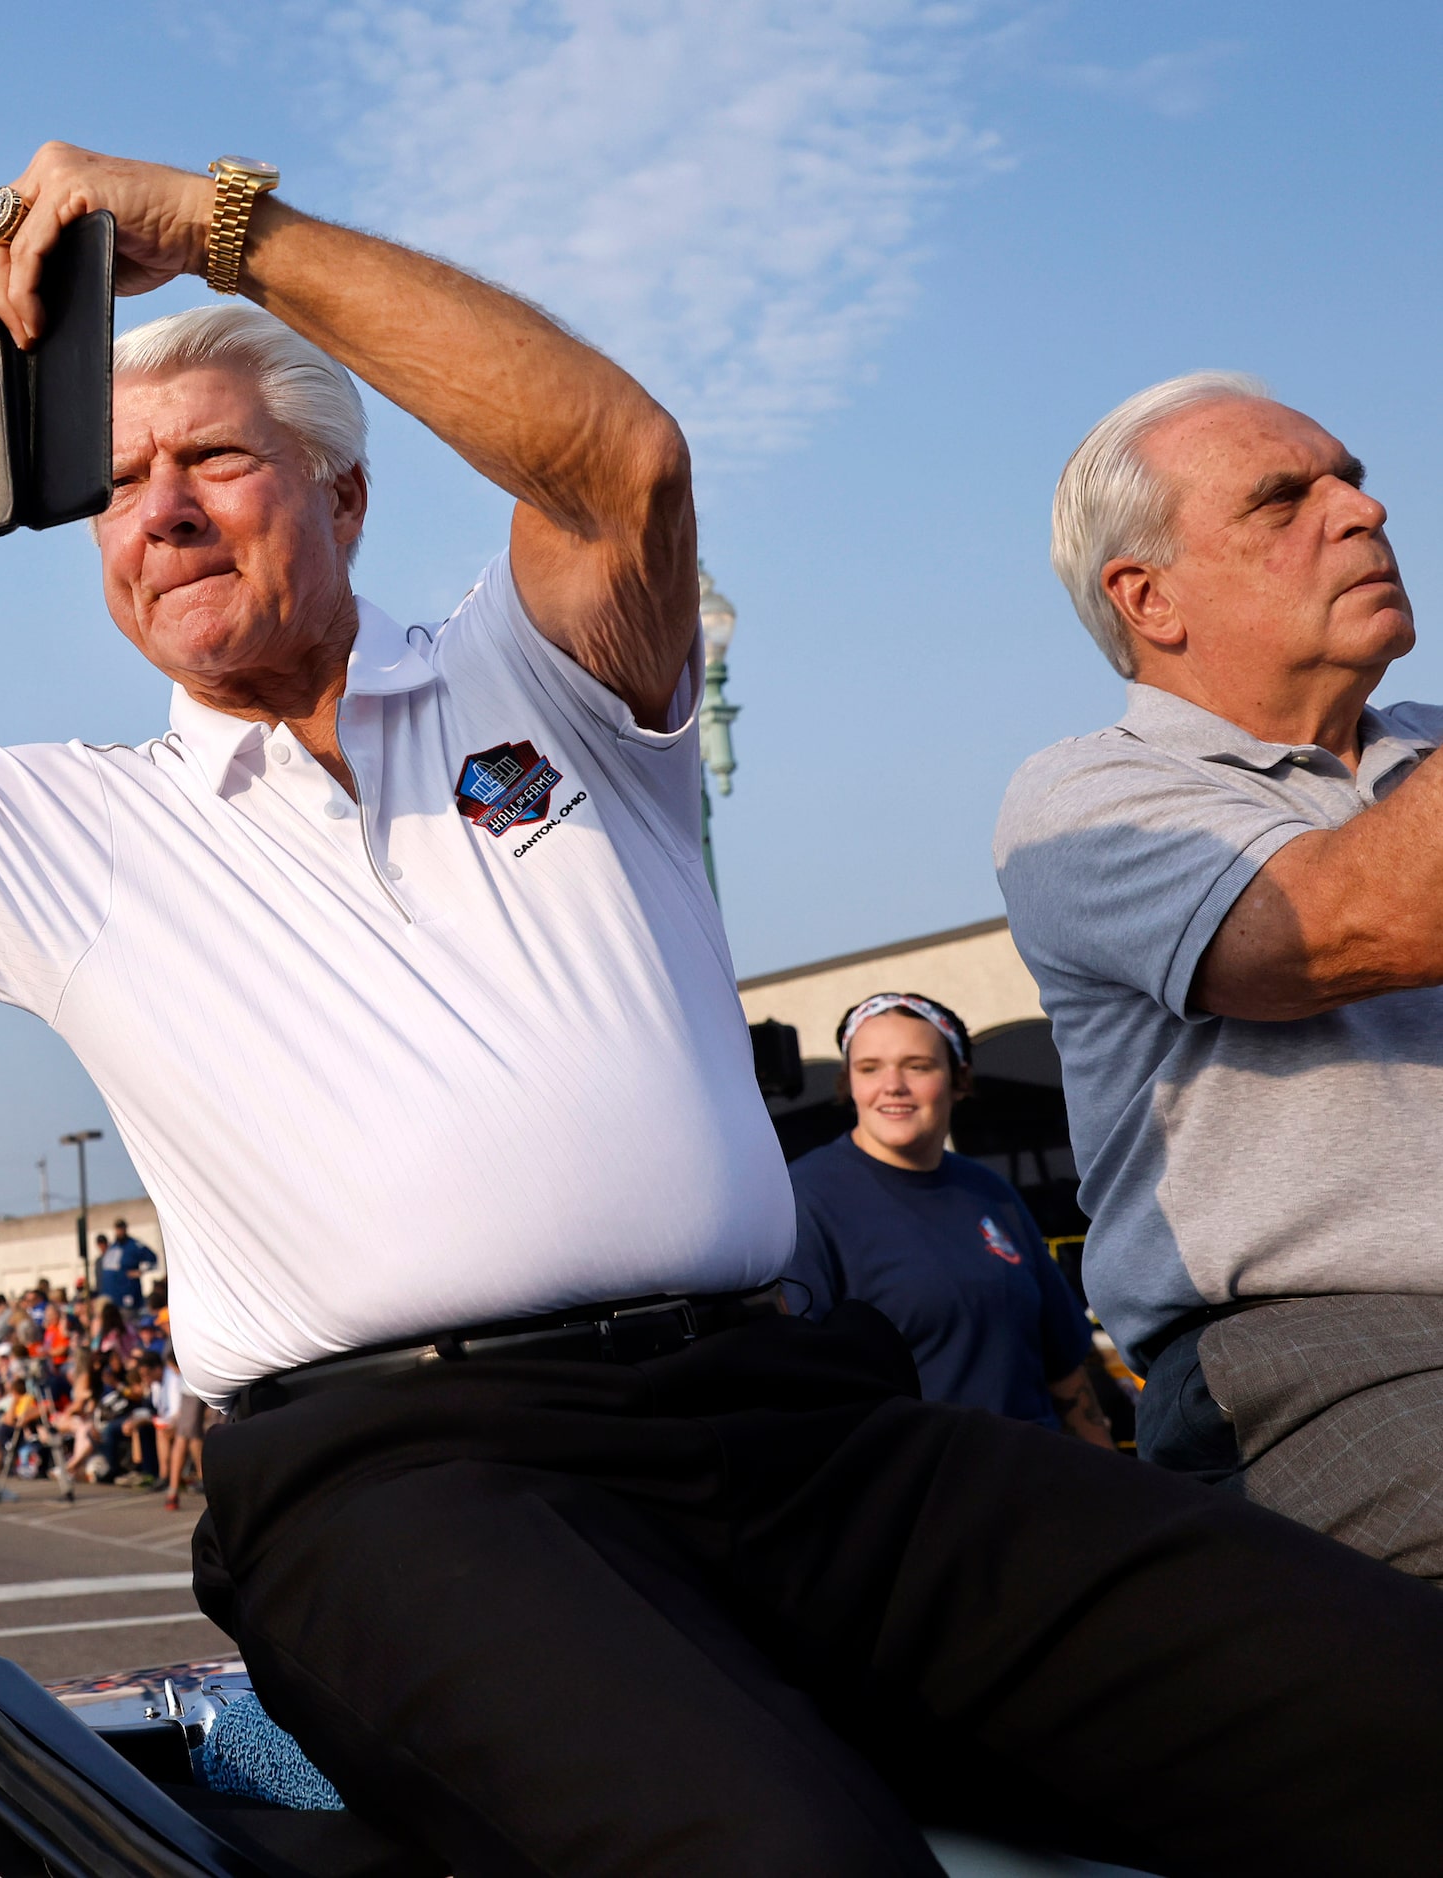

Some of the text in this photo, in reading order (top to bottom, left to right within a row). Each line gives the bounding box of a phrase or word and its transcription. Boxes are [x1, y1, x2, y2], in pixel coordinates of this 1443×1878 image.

[477, 806, 499, 825] PRO
[490, 770, 556, 831] HALL OF FAME
[514, 791, 587, 858] CANTON, OHIO
